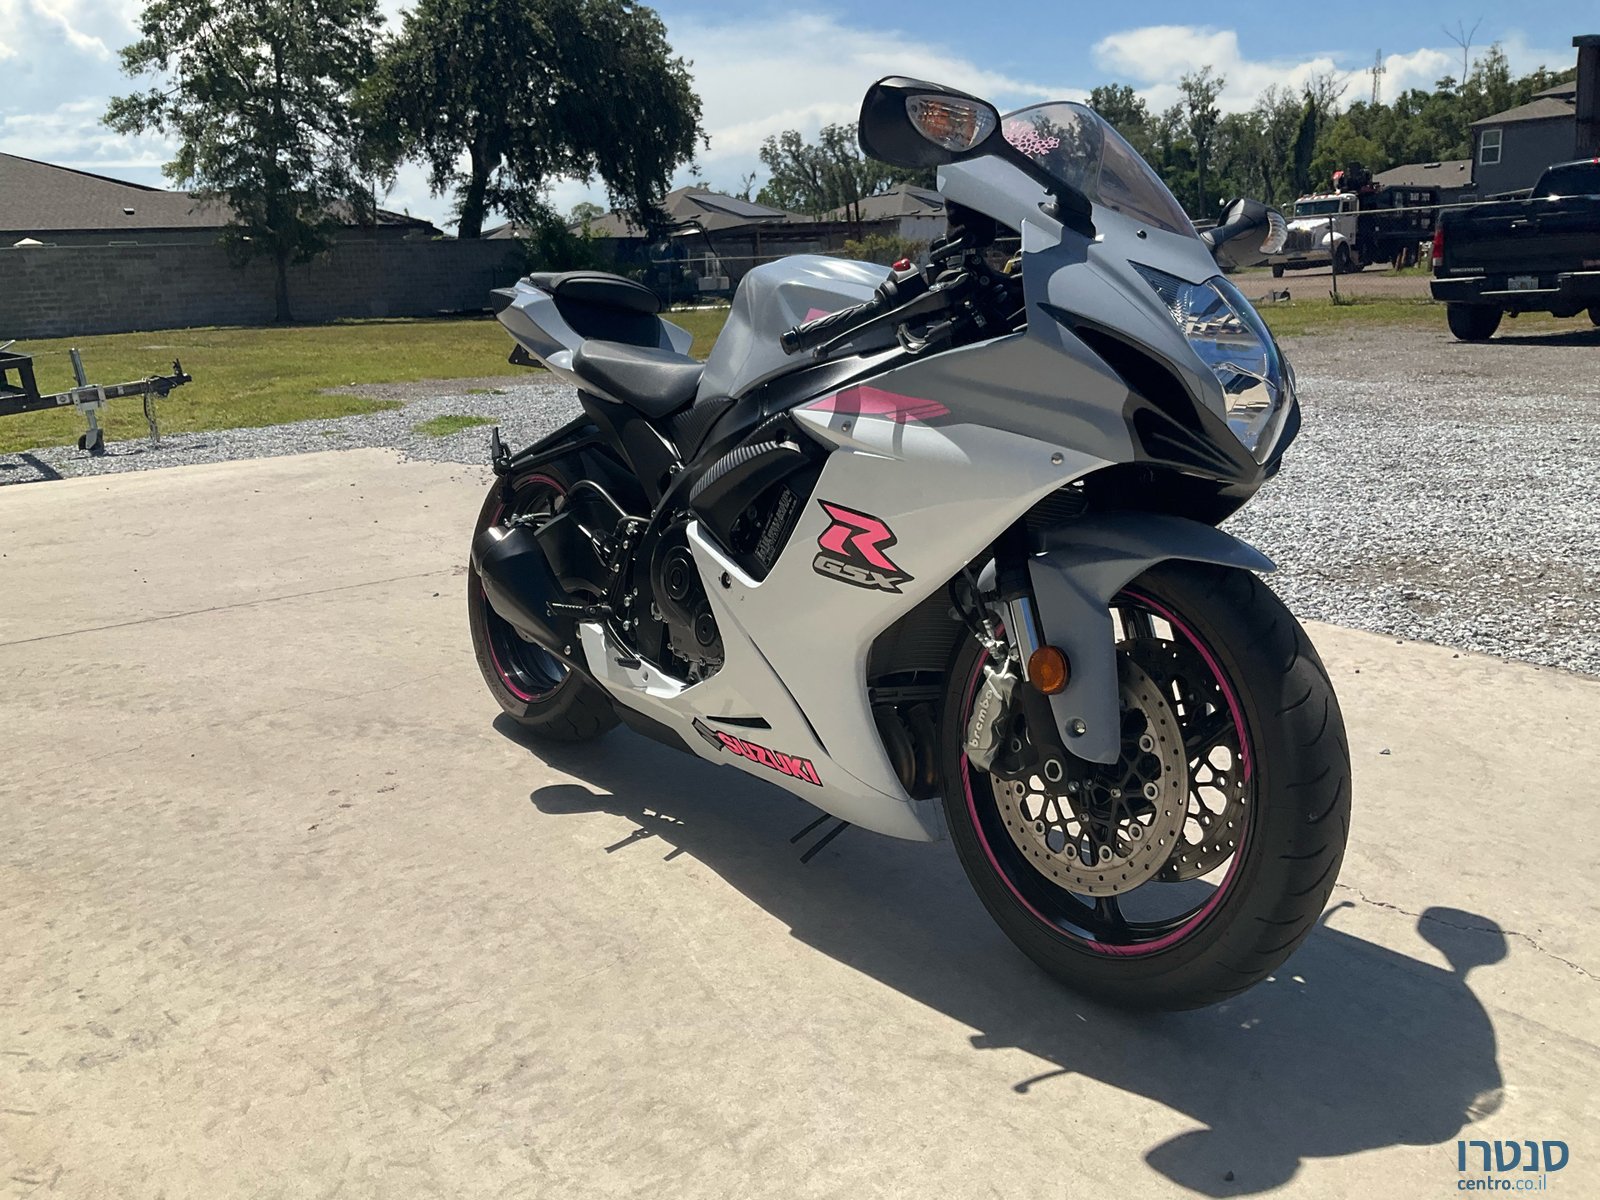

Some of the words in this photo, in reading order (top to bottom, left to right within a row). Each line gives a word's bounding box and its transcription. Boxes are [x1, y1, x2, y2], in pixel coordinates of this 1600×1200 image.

[817, 499, 905, 575] R
[813, 554, 904, 591] GSX
[969, 689, 993, 748] brembo
[715, 730, 823, 787] SUZUKI
